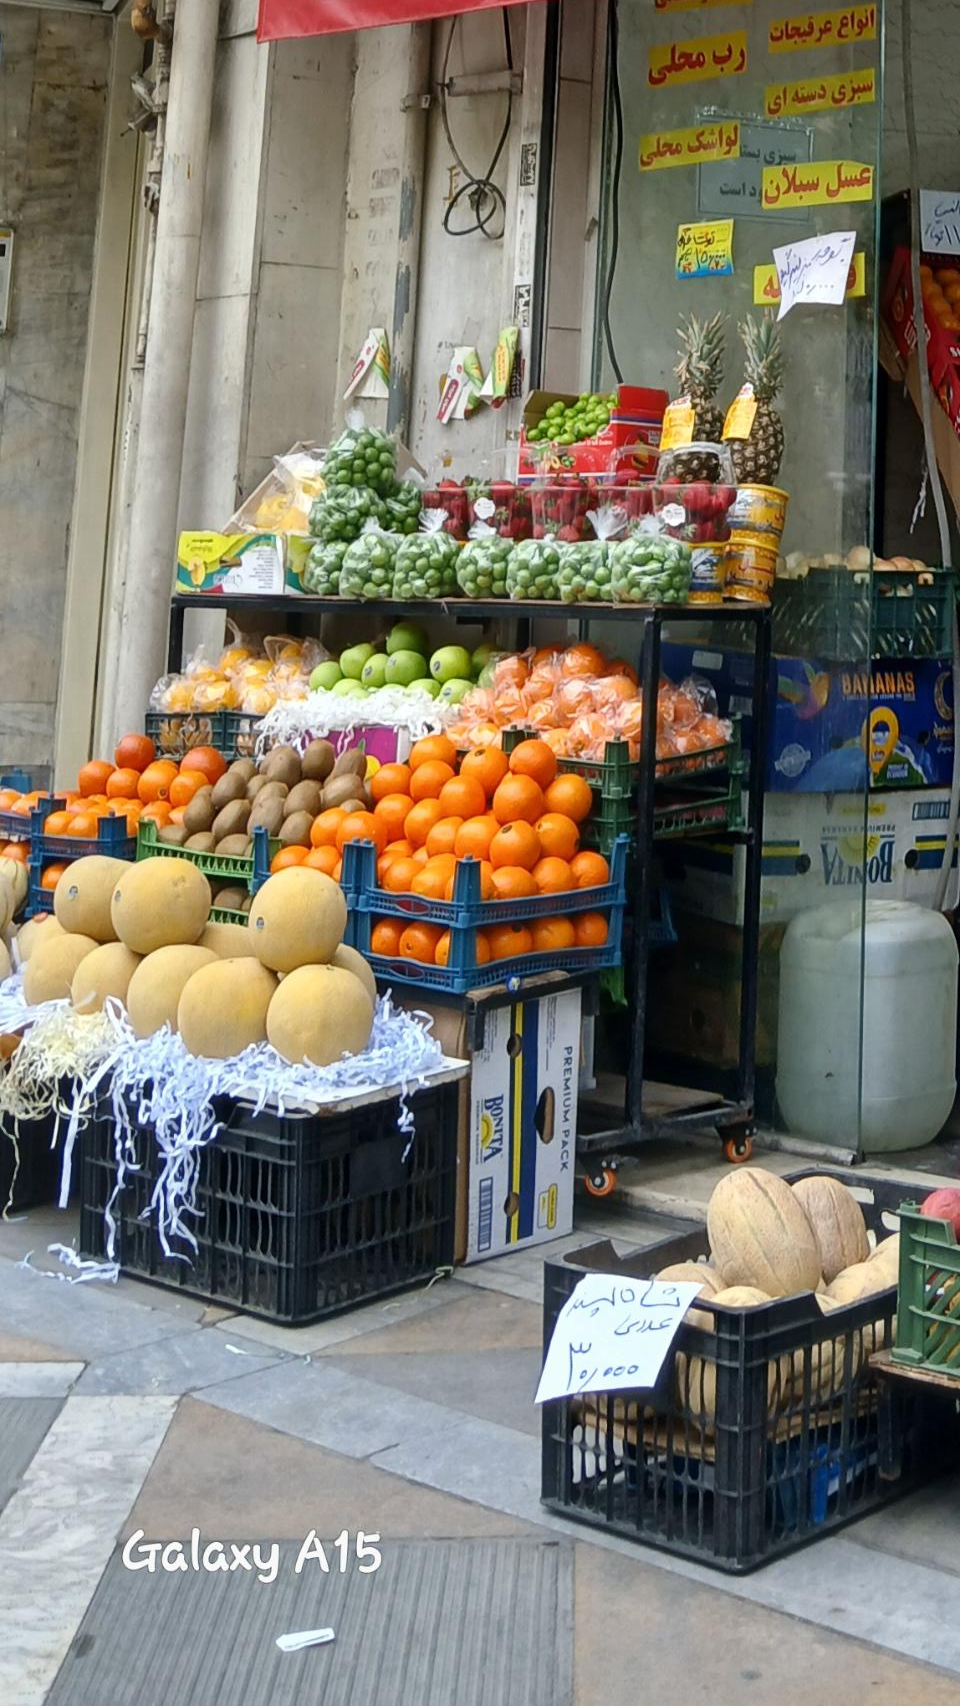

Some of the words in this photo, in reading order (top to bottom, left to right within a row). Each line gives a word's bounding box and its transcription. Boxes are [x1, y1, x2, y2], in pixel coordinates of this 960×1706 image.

[769, 19, 832, 46] عرقیجات
[837, 8, 874, 37] انواع
[648, 45, 707, 85] محلی
[712, 42, 746, 71] رب
[767, 93, 788, 116] ای
[791, 88, 827, 108] دسته
[831, 80, 873, 107] سبزی
[639, 136, 682, 167] محلی
[687, 124, 738, 157] لواشک
[764, 151, 797, 165] سبزی
[764, 165, 819, 204] سبلان
[825, 162, 871, 199] عسل
[820, 840, 896, 886] BONITA
[563, 1046, 573, 1121] PREMIUM
[483, 1094, 504, 1163] BONITA
[559, 1122, 571, 1172] PACK
